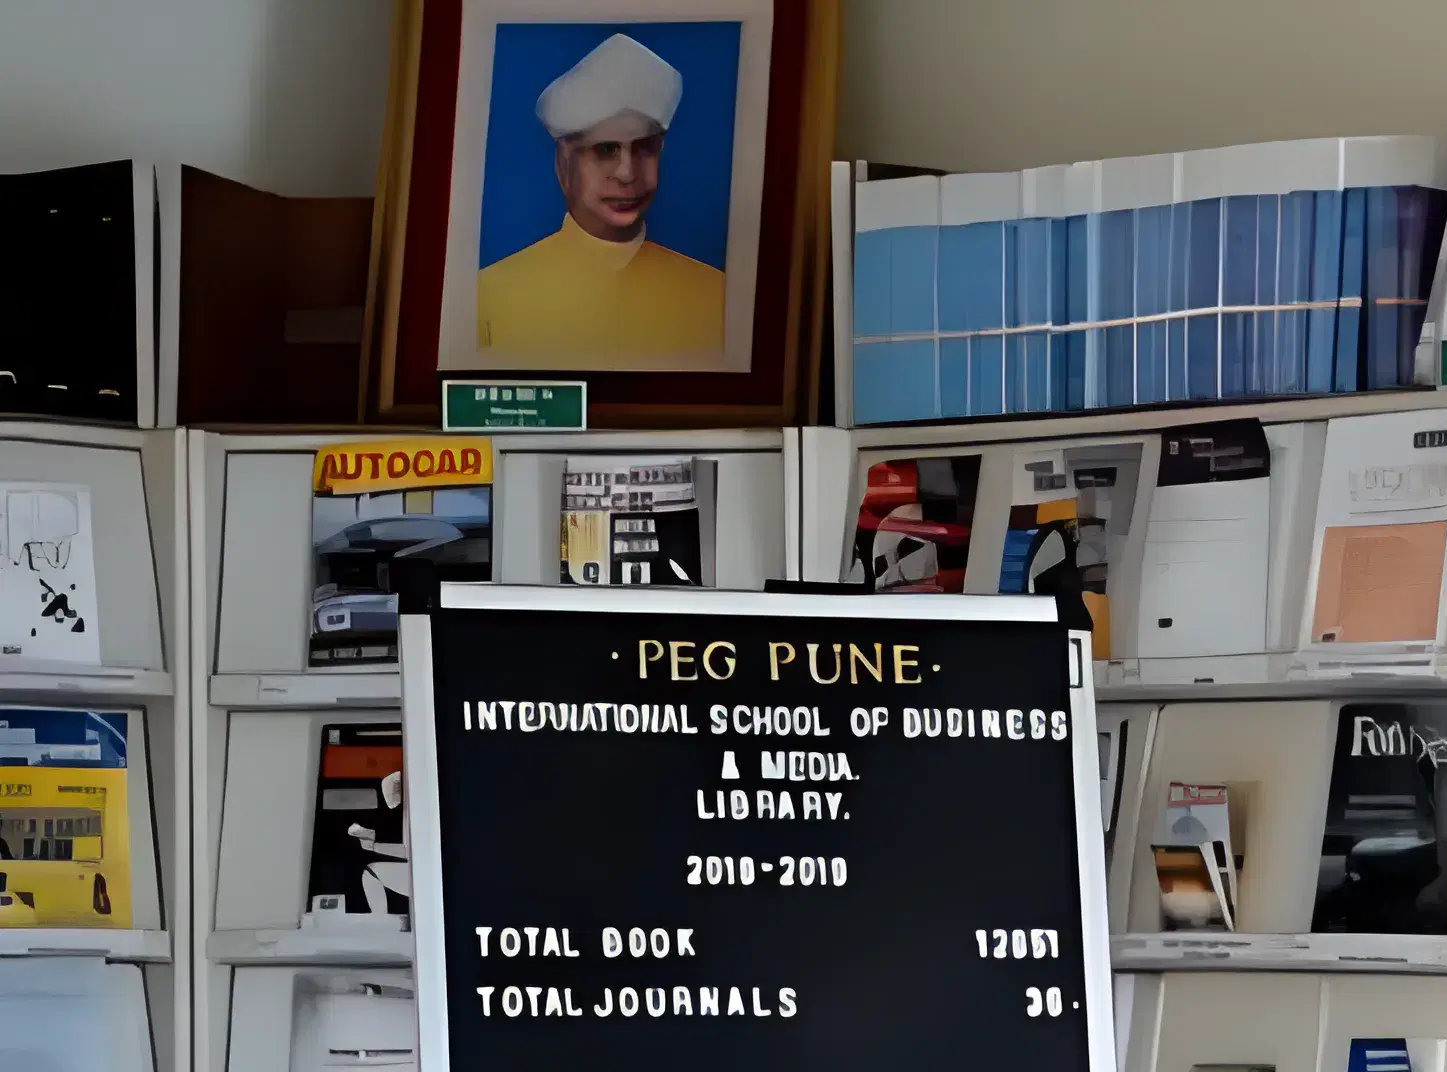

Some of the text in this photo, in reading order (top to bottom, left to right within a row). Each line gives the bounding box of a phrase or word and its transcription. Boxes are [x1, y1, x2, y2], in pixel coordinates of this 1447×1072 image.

[639, 640, 922, 685] PEG PUNE
[710, 704, 830, 737] SCHOOL
[476, 926, 579, 957] TOTAL
[477, 986, 582, 1017] TOTAL
[594, 986, 797, 1018] JOURNALS
